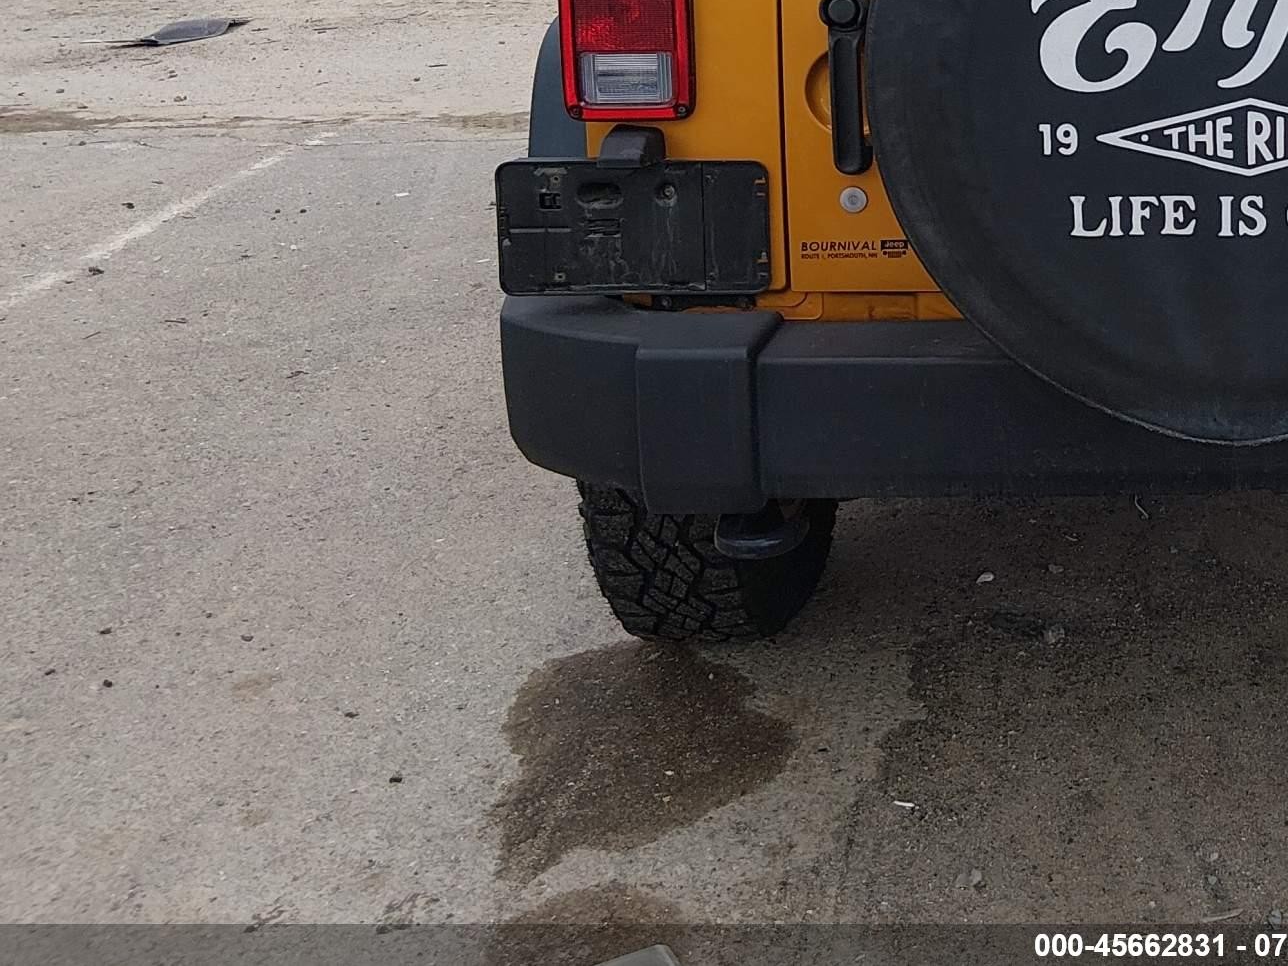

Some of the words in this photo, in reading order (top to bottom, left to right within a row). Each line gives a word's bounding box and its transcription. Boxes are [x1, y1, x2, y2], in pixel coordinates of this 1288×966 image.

[1038, 123, 1078, 156] 19
[1163, 116, 1234, 159] THE
[1069, 195, 1197, 237] LIFE
[1218, 195, 1267, 237] IS
[801, 241, 877, 252] BOURNIVAL
